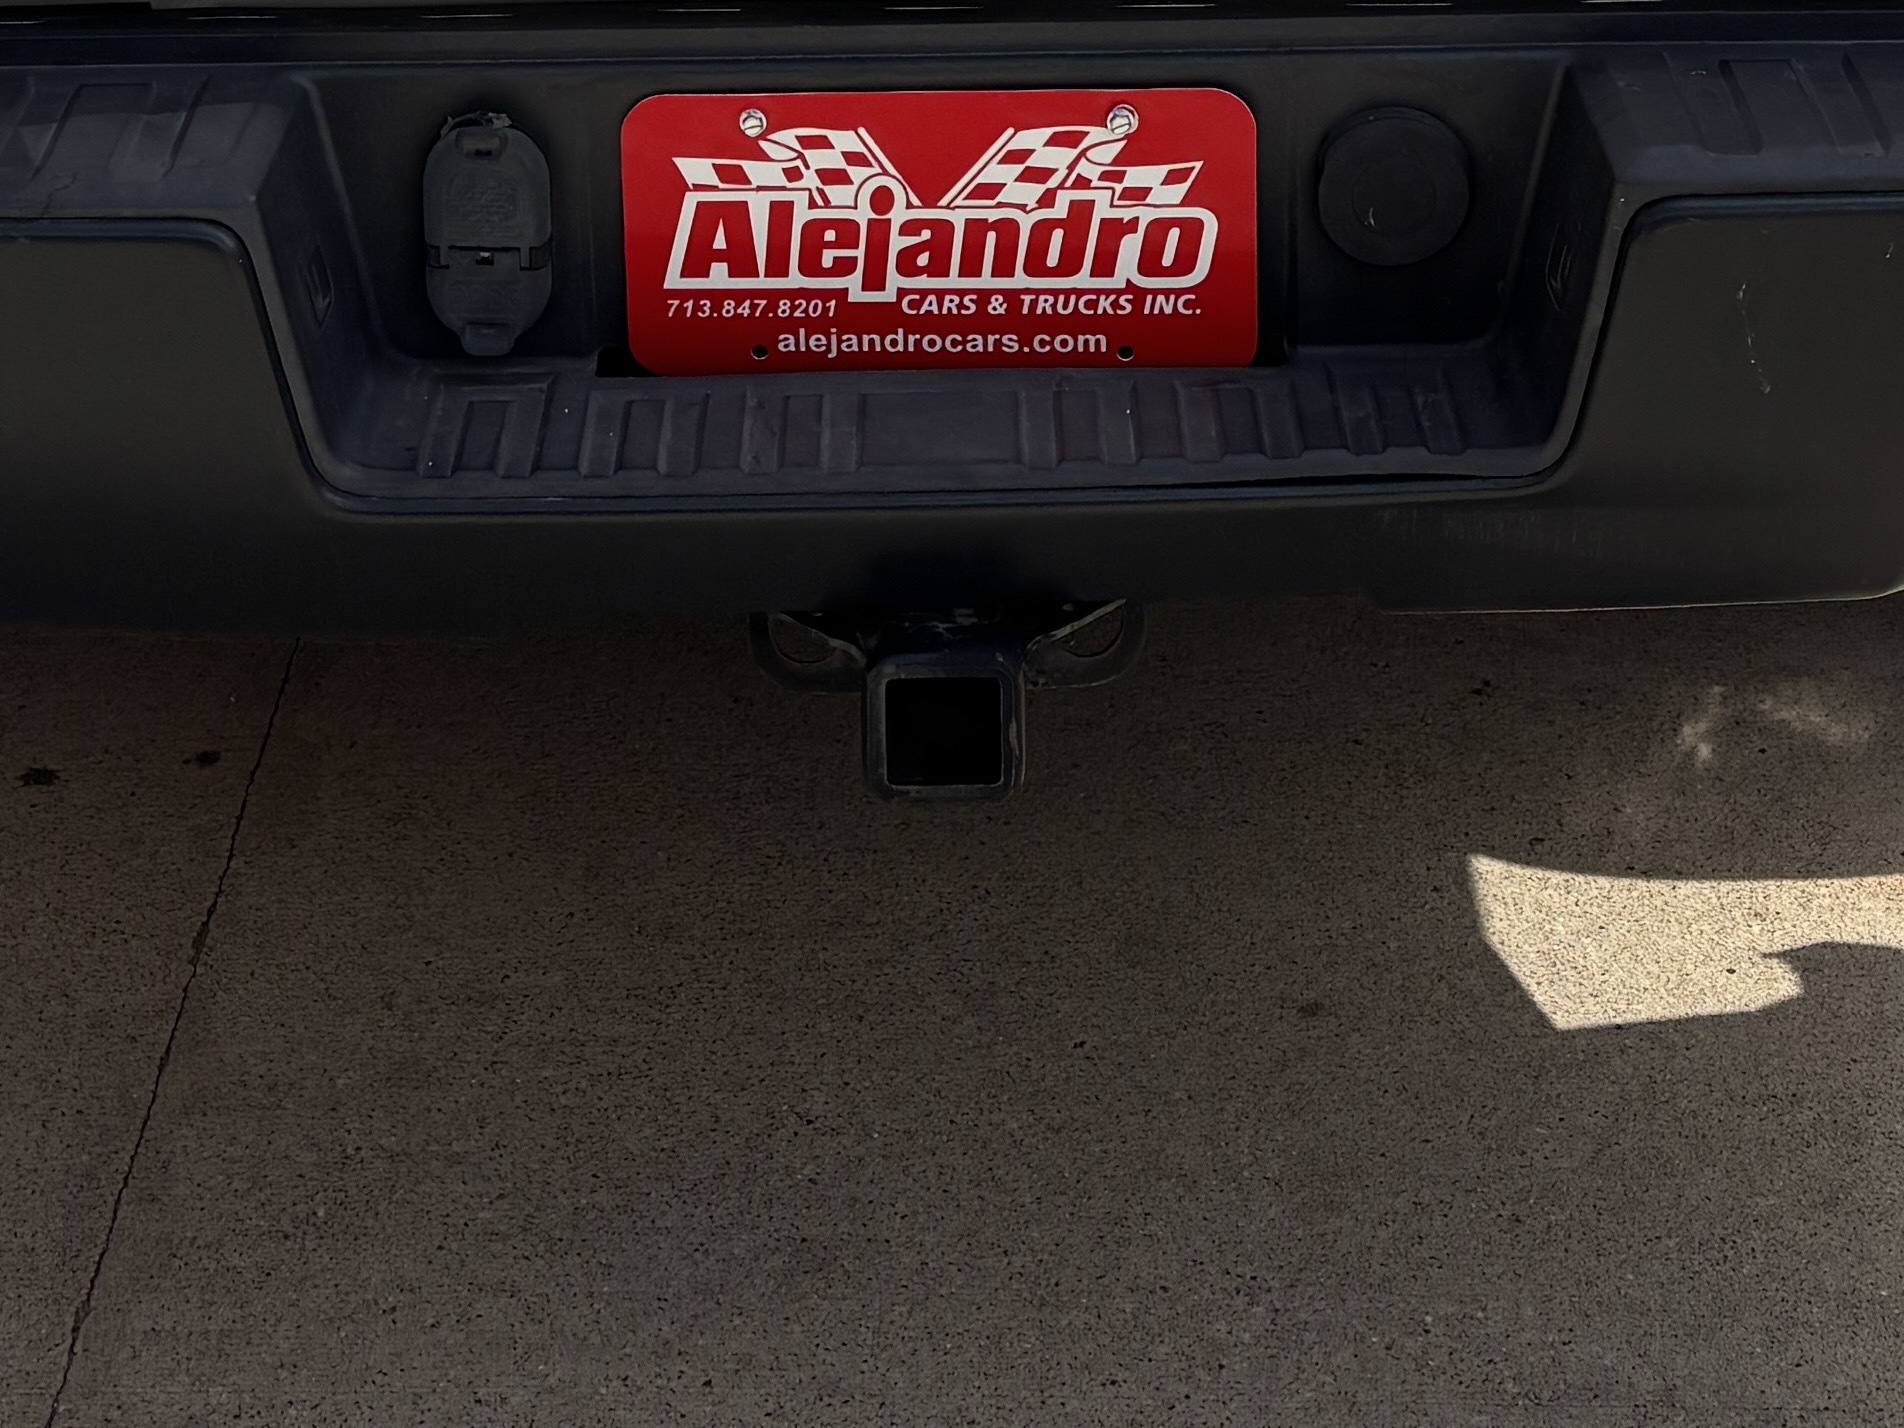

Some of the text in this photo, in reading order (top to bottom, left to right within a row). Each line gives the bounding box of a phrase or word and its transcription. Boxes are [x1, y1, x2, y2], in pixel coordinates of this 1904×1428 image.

[679, 184, 1203, 293] Alejandro
[665, 294, 1202, 319] 713.847.8201 CARS & TRUCKS INC.
[776, 327, 1108, 358] alejandrocars.com
